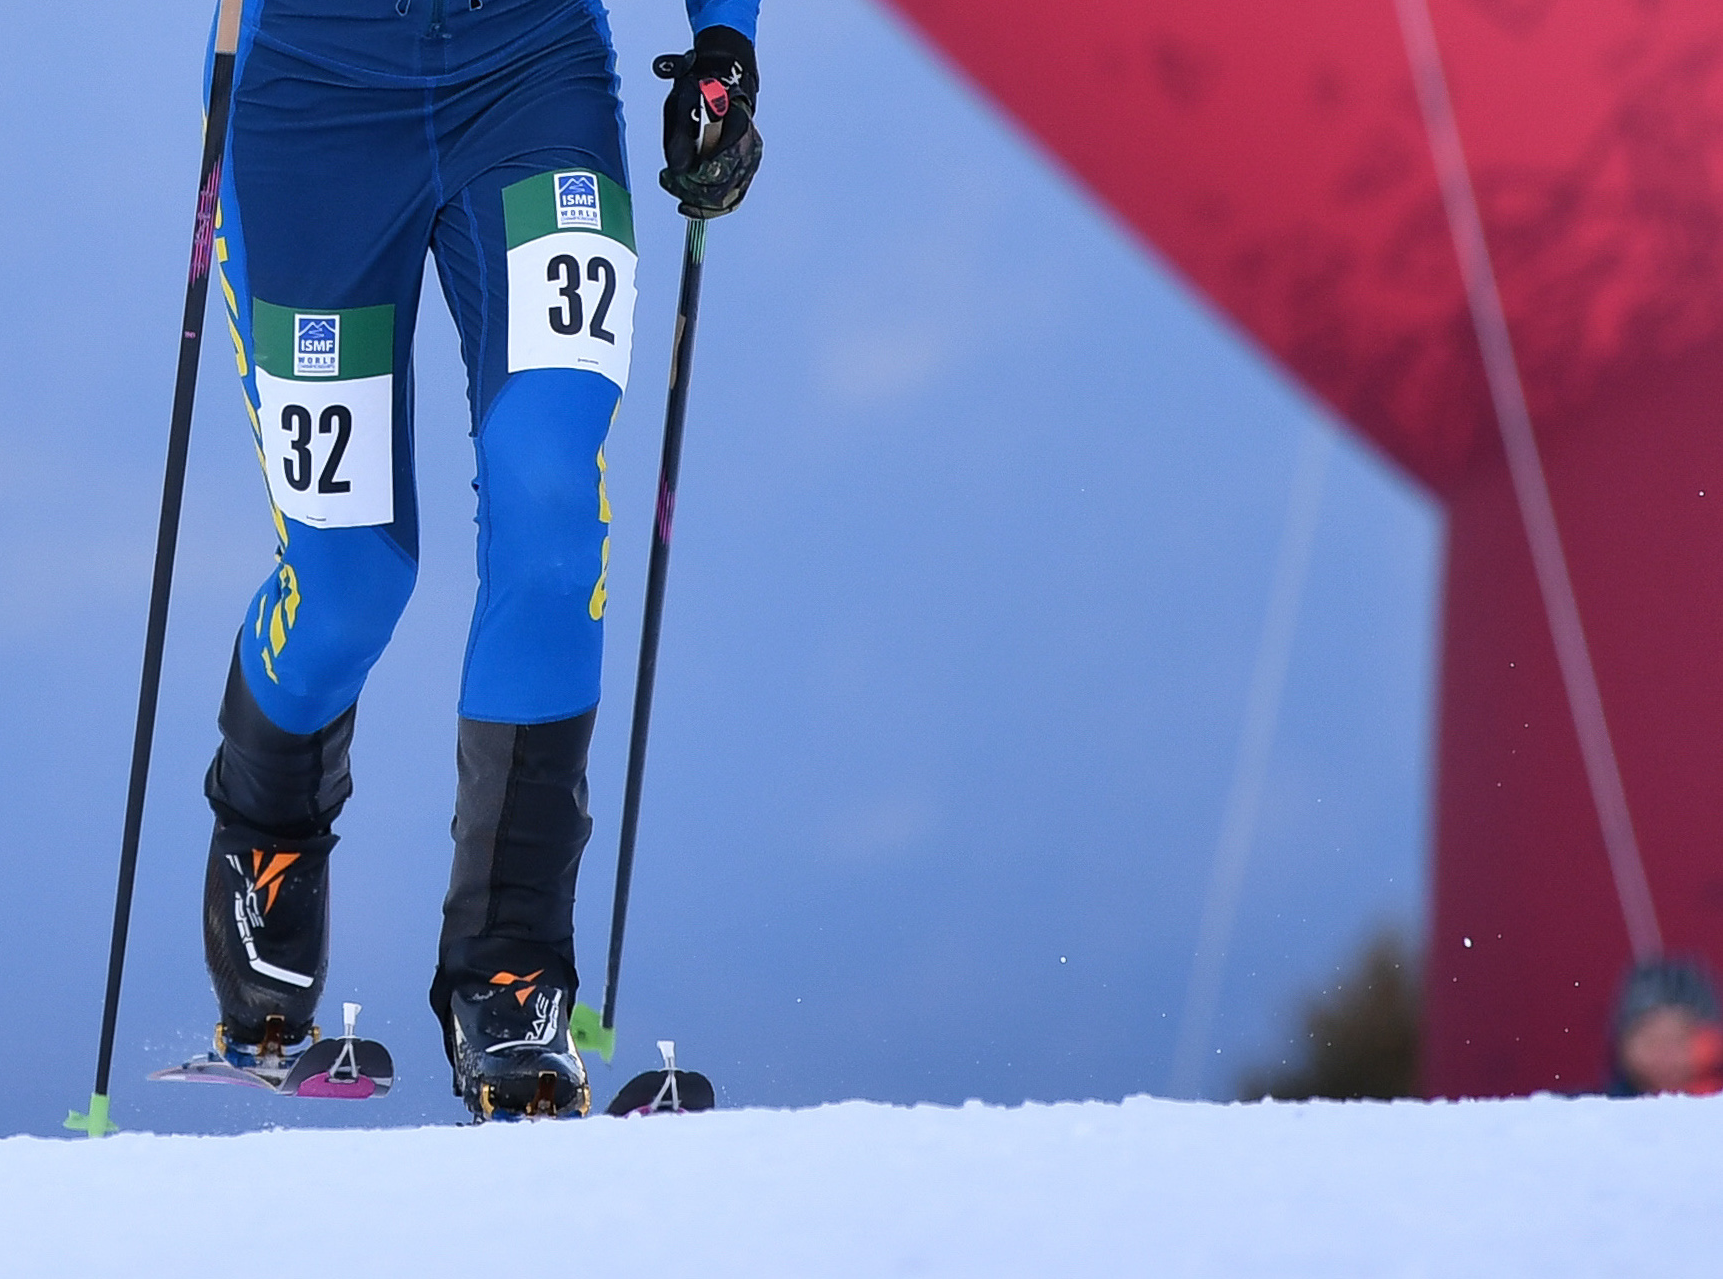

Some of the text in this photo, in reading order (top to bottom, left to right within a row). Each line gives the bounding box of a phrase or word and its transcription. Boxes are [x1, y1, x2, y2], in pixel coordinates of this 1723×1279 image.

[562, 194, 594, 206] ISMF
[560, 209, 598, 218] WORLD
[546, 254, 616, 345] 32
[301, 339, 333, 352] ISMF
[298, 356, 335, 364] WORLD
[281, 405, 352, 494] 32
